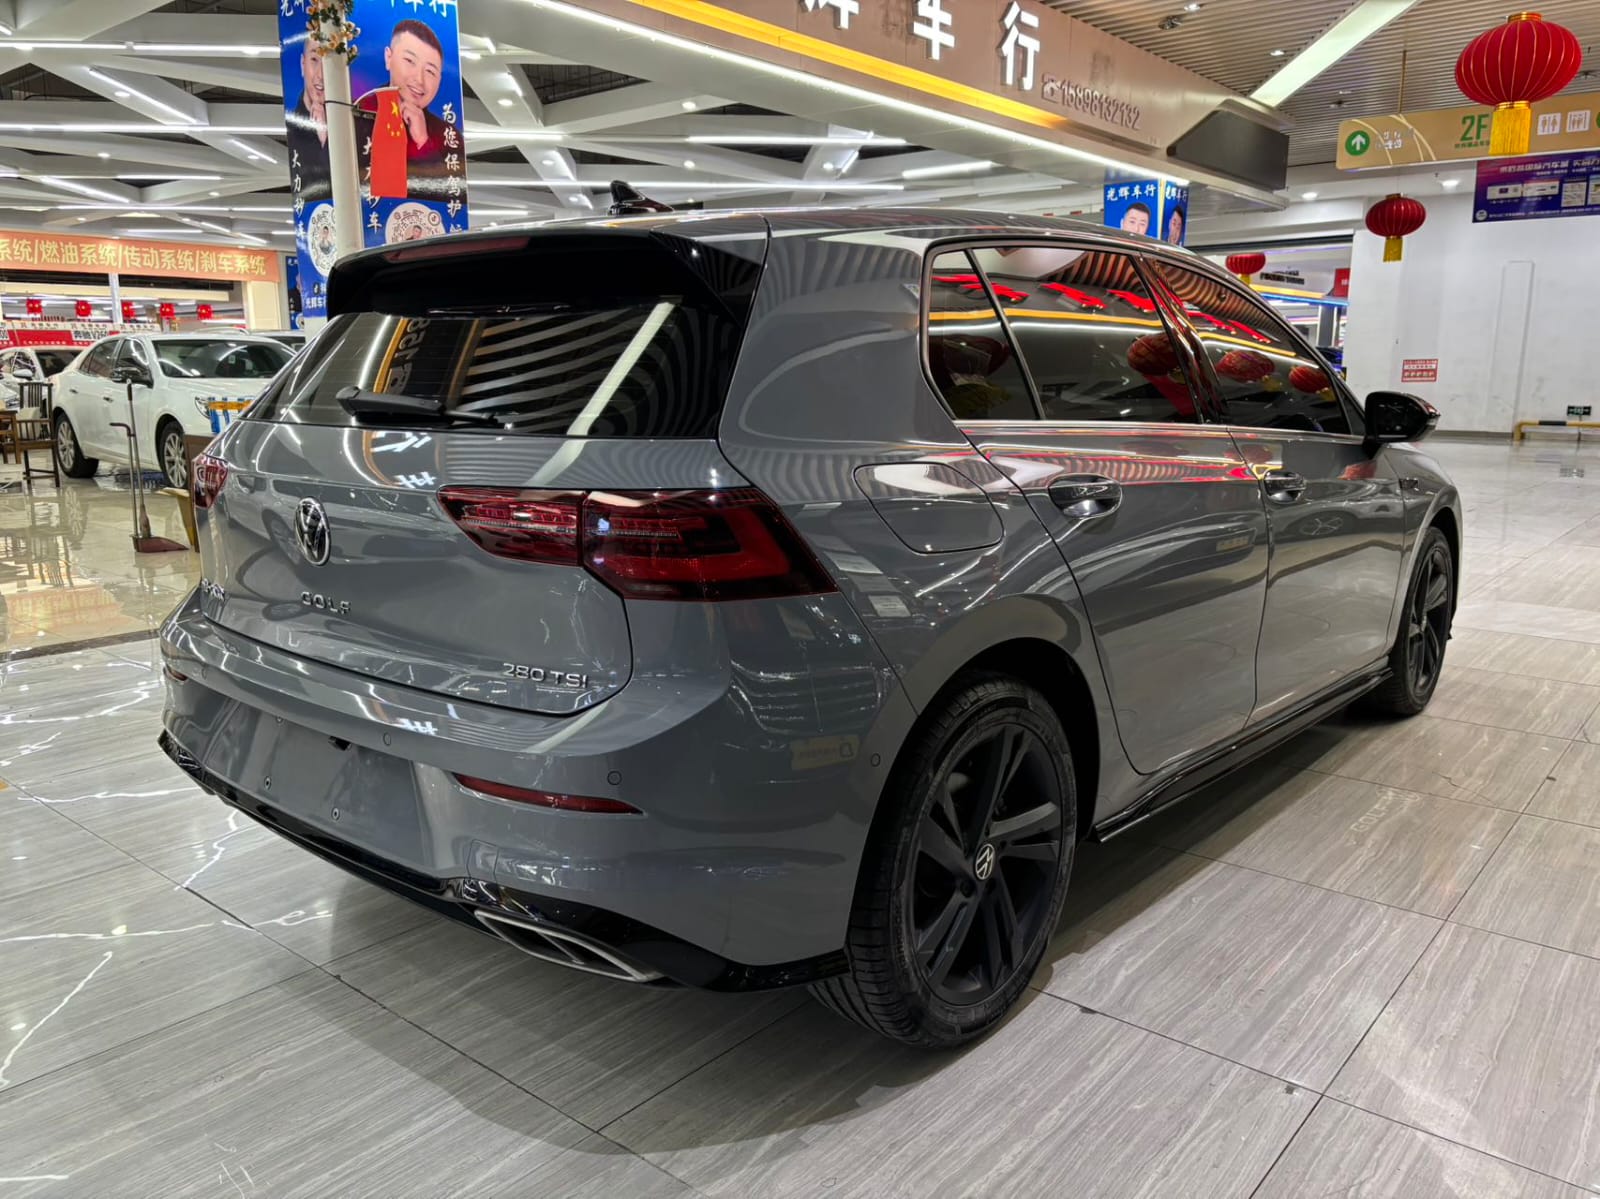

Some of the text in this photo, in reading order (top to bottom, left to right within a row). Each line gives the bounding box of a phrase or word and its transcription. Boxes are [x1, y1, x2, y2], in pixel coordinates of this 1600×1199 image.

[1460, 113, 1491, 142] 2F
[301, 591, 351, 615] GOLF
[503, 662, 588, 688] 280 TSI
